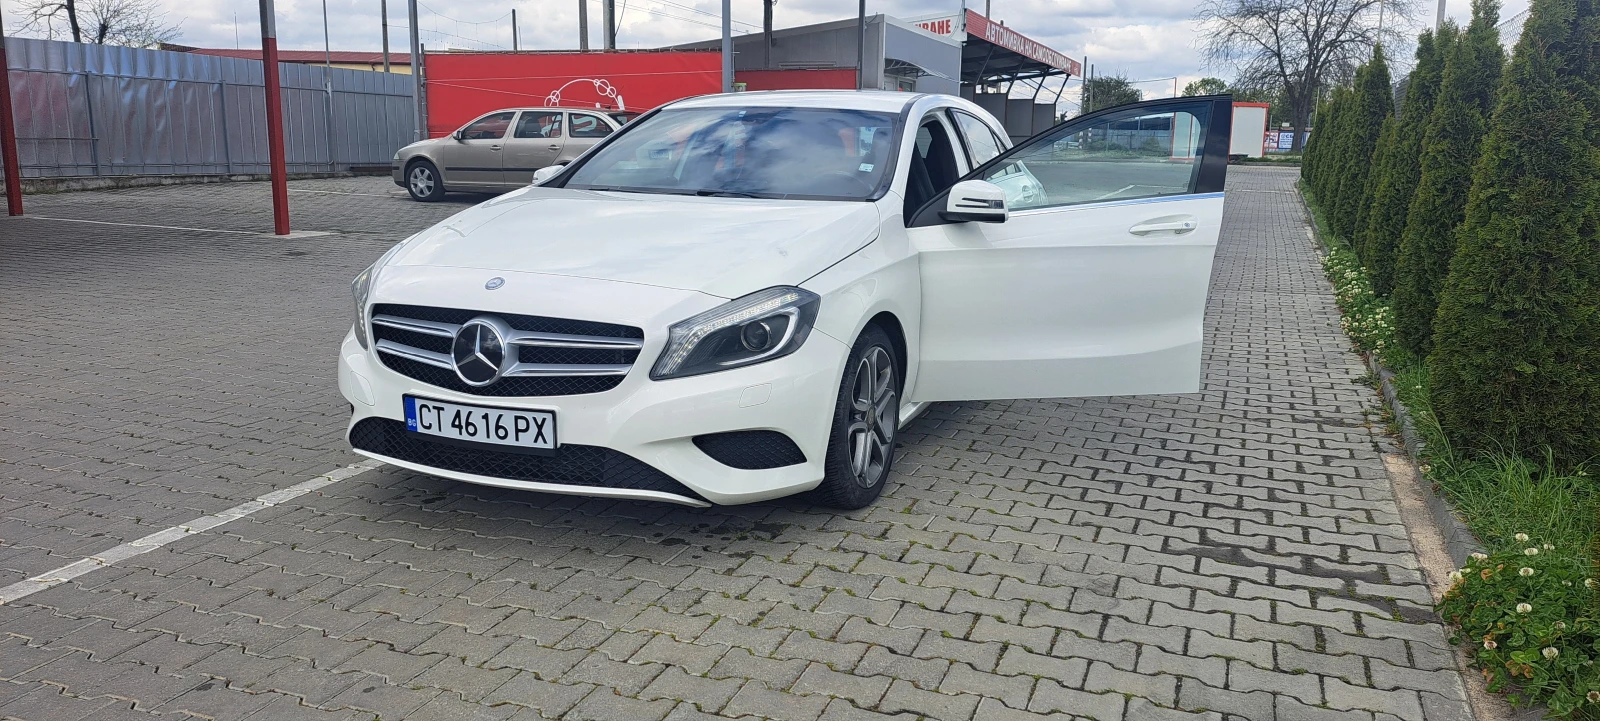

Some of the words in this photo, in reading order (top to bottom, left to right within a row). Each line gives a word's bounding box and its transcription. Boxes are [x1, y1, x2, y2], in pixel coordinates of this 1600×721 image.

[985, 22, 1024, 53] АВТОМИВКА
[1025, 39, 1033, 56] НА
[408, 418, 417, 427] BG
[419, 404, 445, 432] CT
[451, 409, 509, 440] 4616
[514, 415, 548, 444] PX
